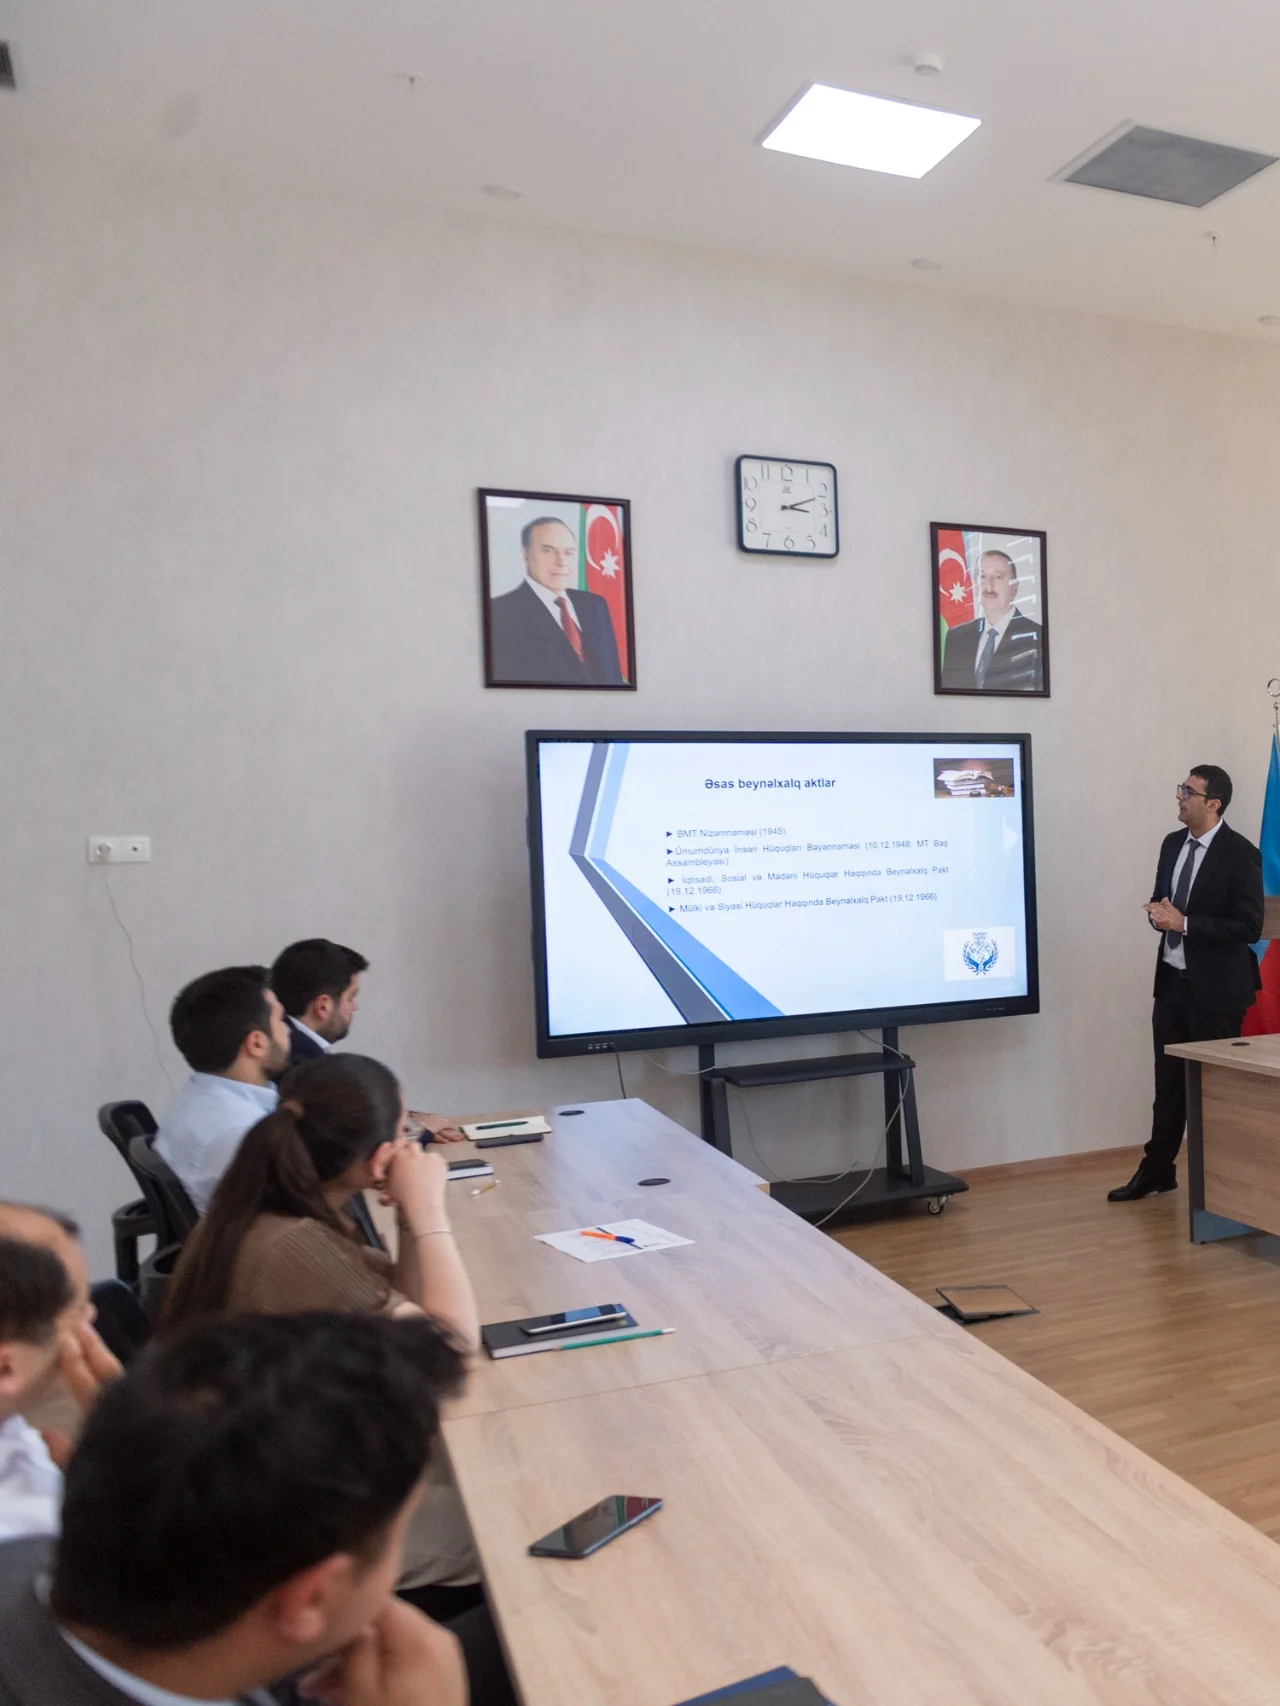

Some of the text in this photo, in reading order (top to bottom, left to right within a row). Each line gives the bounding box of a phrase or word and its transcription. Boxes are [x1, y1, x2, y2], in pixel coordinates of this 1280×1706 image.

[761, 463, 770, 480] 11
[780, 463, 793, 482] 12
[743, 476, 757, 491] 10
[817, 482, 828, 499] 2
[745, 497, 756, 512] 9
[818, 503, 828, 517] 3
[745, 517, 757, 533] 8
[819, 523, 828, 538] 4
[762, 532, 771, 548] 7
[783, 535, 795, 550] 6
[805, 535, 816, 550] 5
[704, 778, 836, 791] Əsas beynəlxalq aktlar
[677, 827, 786, 838] BMT Nizamnaməsi (1945)
[675, 845, 730, 856] Ümumdünya
[721, 873, 747, 882] Sosial
[767, 872, 798, 881] Mədəni
[803, 871, 839, 881] Hüquqlar
[932, 866, 949, 874] Pakt
[717, 902, 744, 912] Siyasi
[745, 900, 783, 911] Hüquqlar
[870, 894, 888, 903] Pakt
